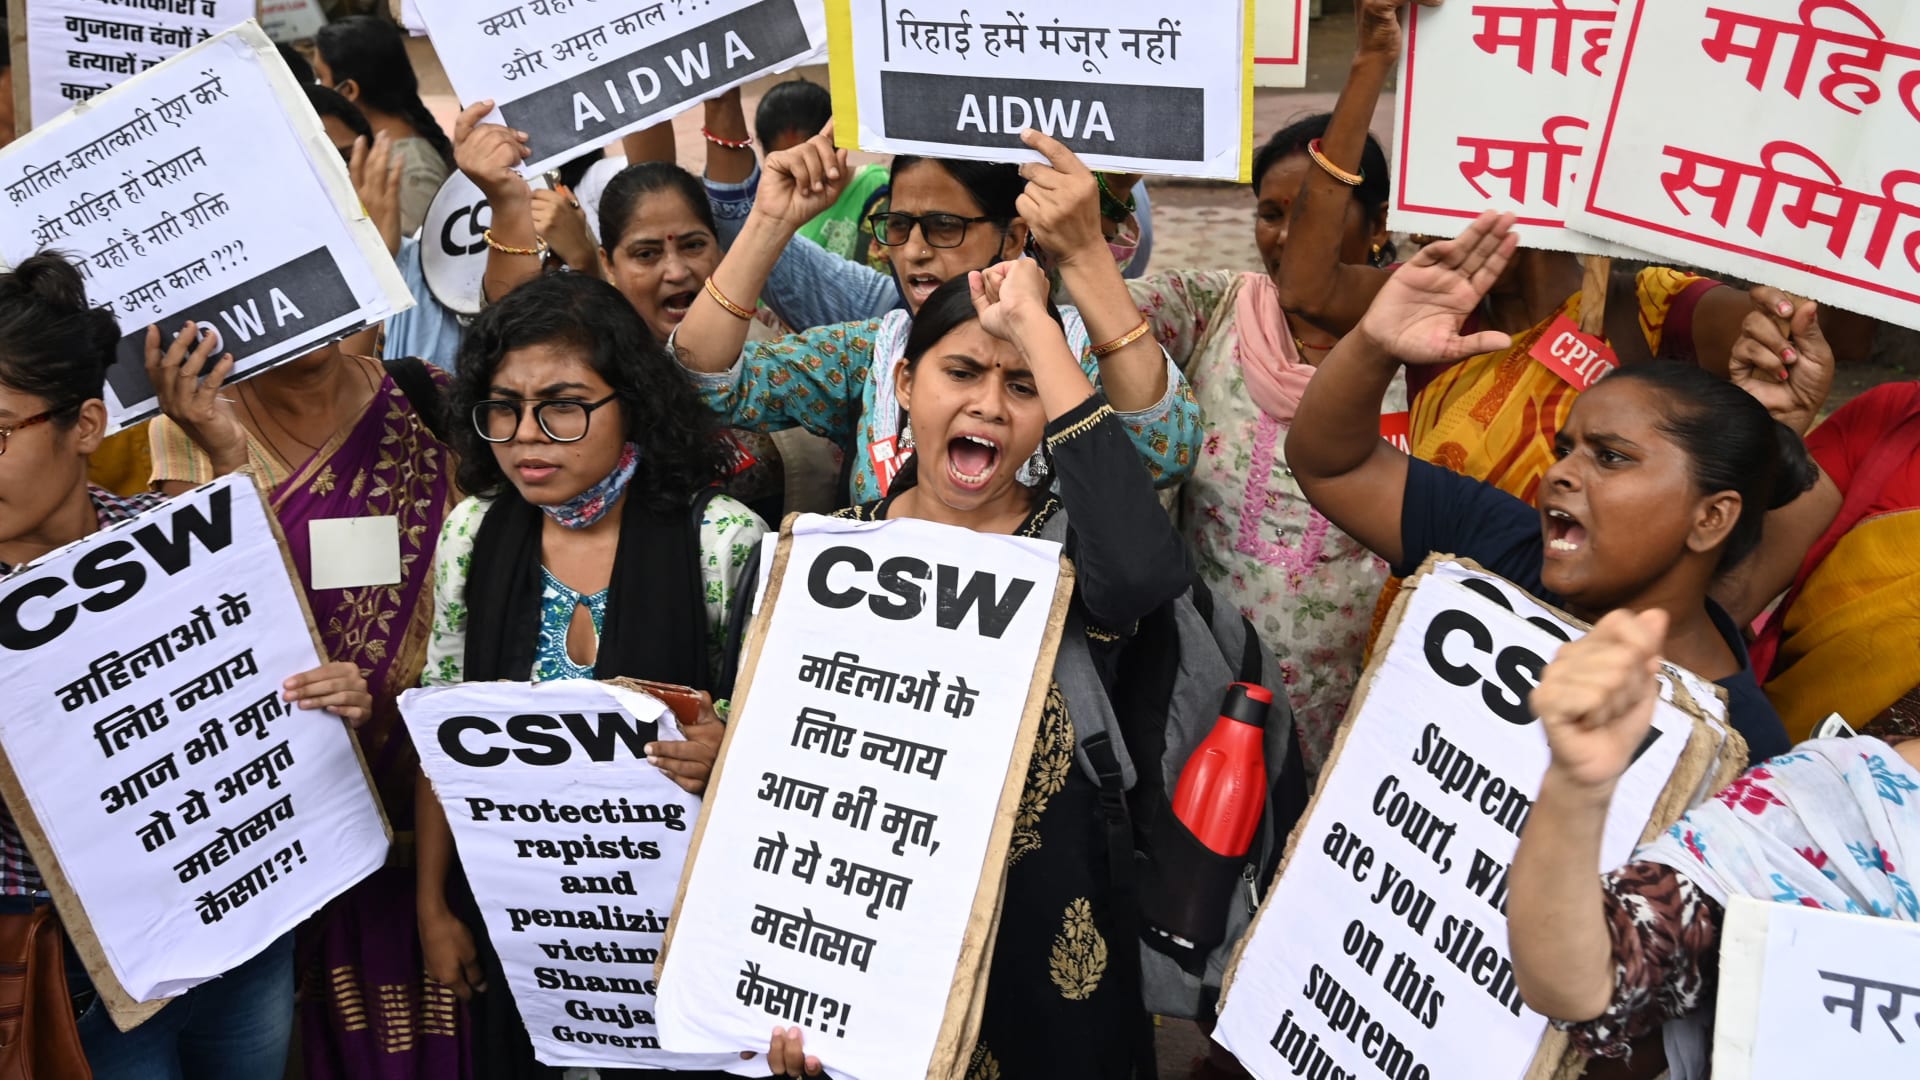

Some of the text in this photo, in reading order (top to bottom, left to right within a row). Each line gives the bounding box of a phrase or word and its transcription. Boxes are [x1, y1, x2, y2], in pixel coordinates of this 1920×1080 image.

[64, 16, 145, 43] गुजरात
[478, 8, 529, 37] क्या
[502, 48, 547, 82] और
[552, 25, 609, 62] अमृत
[609, 2, 666, 37] काल
[896, 9, 1181, 73] रिहाई हमें मंजूर नहीं
[66, 50, 137, 75] हत्यारों
[151, 97, 192, 127] ऐश
[189, 68, 229, 105] करें
[574, 31, 754, 130] AIDWA
[956, 93, 1115, 142] AIDWA
[31, 147, 207, 247] और पीड़ित हों परेशान
[90, 191, 230, 269] यही है नारी शक्ति
[119, 279, 168, 314] अमृत
[163, 258, 212, 289] काल
[211, 239, 249, 273] ???
[0, 486, 231, 650] CSW
[808, 546, 1035, 638] CSW
[55, 594, 250, 711] महिलाओं के
[799, 652, 979, 718] महिलाओं के
[94, 648, 258, 757] लिए न्याय
[101, 753, 179, 813] आज
[184, 719, 228, 764] भी
[791, 707, 947, 780] लिए न्याय
[136, 741, 294, 852] तो ये अमृत
[465, 798, 685, 831] Protecting
[758, 772, 939, 856] आज भी मृत,
[1374, 775, 1456, 873] Court,
[174, 794, 294, 883] महोत्सव
[515, 835, 660, 865] rapists
[754, 831, 914, 920] तो ये अमृत
[561, 871, 637, 895] and
[1324, 823, 1373, 881] are
[1371, 863, 1435, 935] you
[751, 904, 876, 972] महोत्सव
[1344, 920, 1446, 1030] on this
[564, 1000, 657, 1028] Guja
[736, 960, 851, 1038] कैसा!?!
[1819, 971, 1920, 1043] नर
